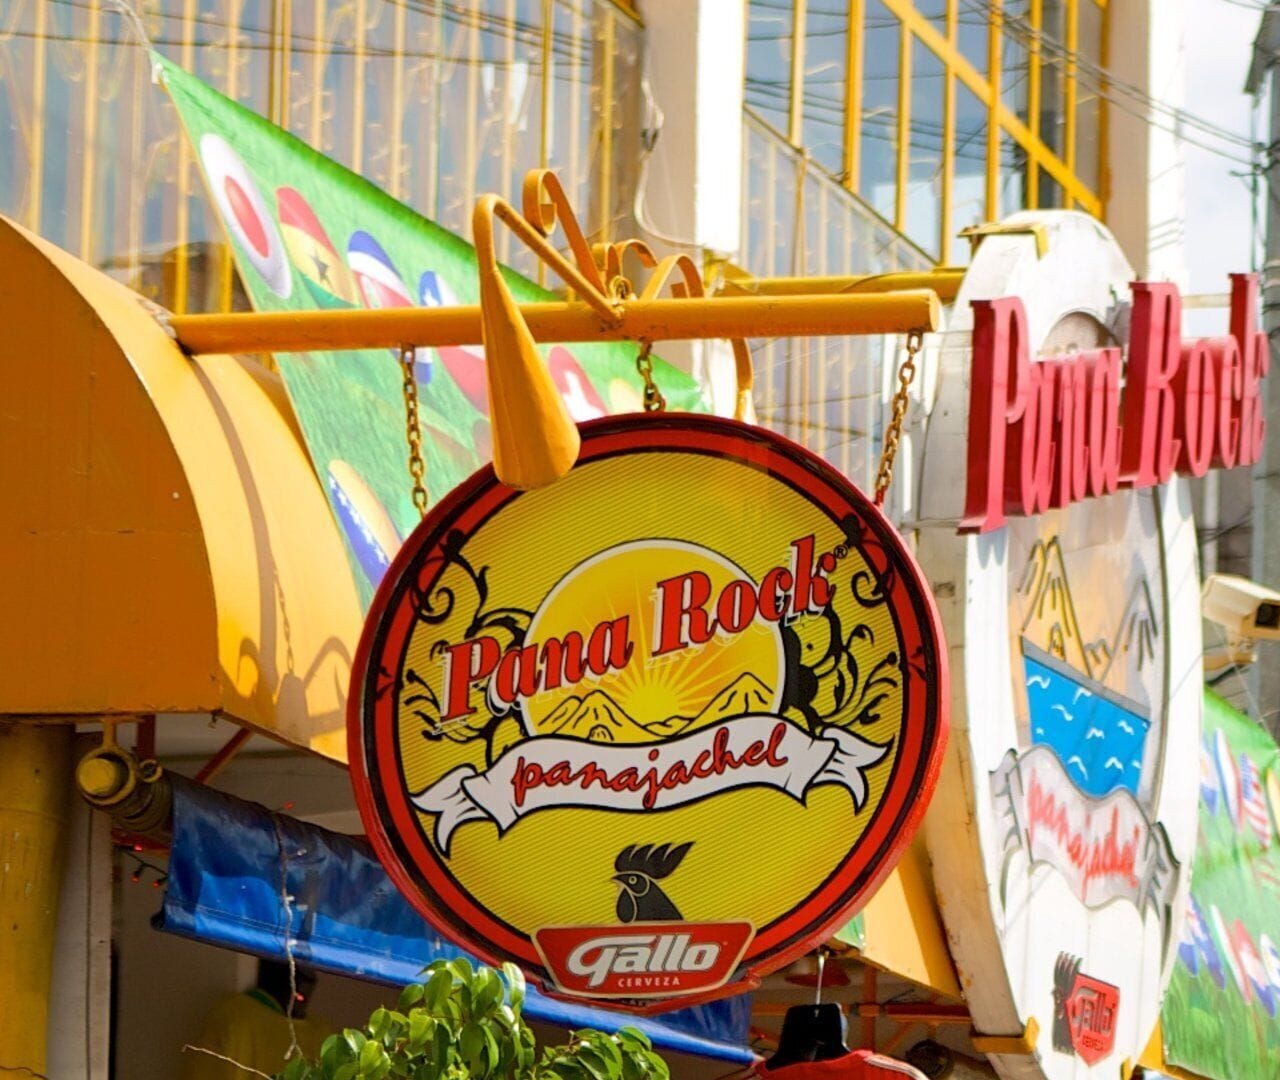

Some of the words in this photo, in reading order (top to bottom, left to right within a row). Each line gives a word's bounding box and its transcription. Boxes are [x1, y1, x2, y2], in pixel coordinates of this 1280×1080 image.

[439, 610, 633, 724] Pana
[511, 722, 789, 808] panajachel
[565, 932, 723, 990] Gallo
[617, 974, 681, 990] CERVEZA
